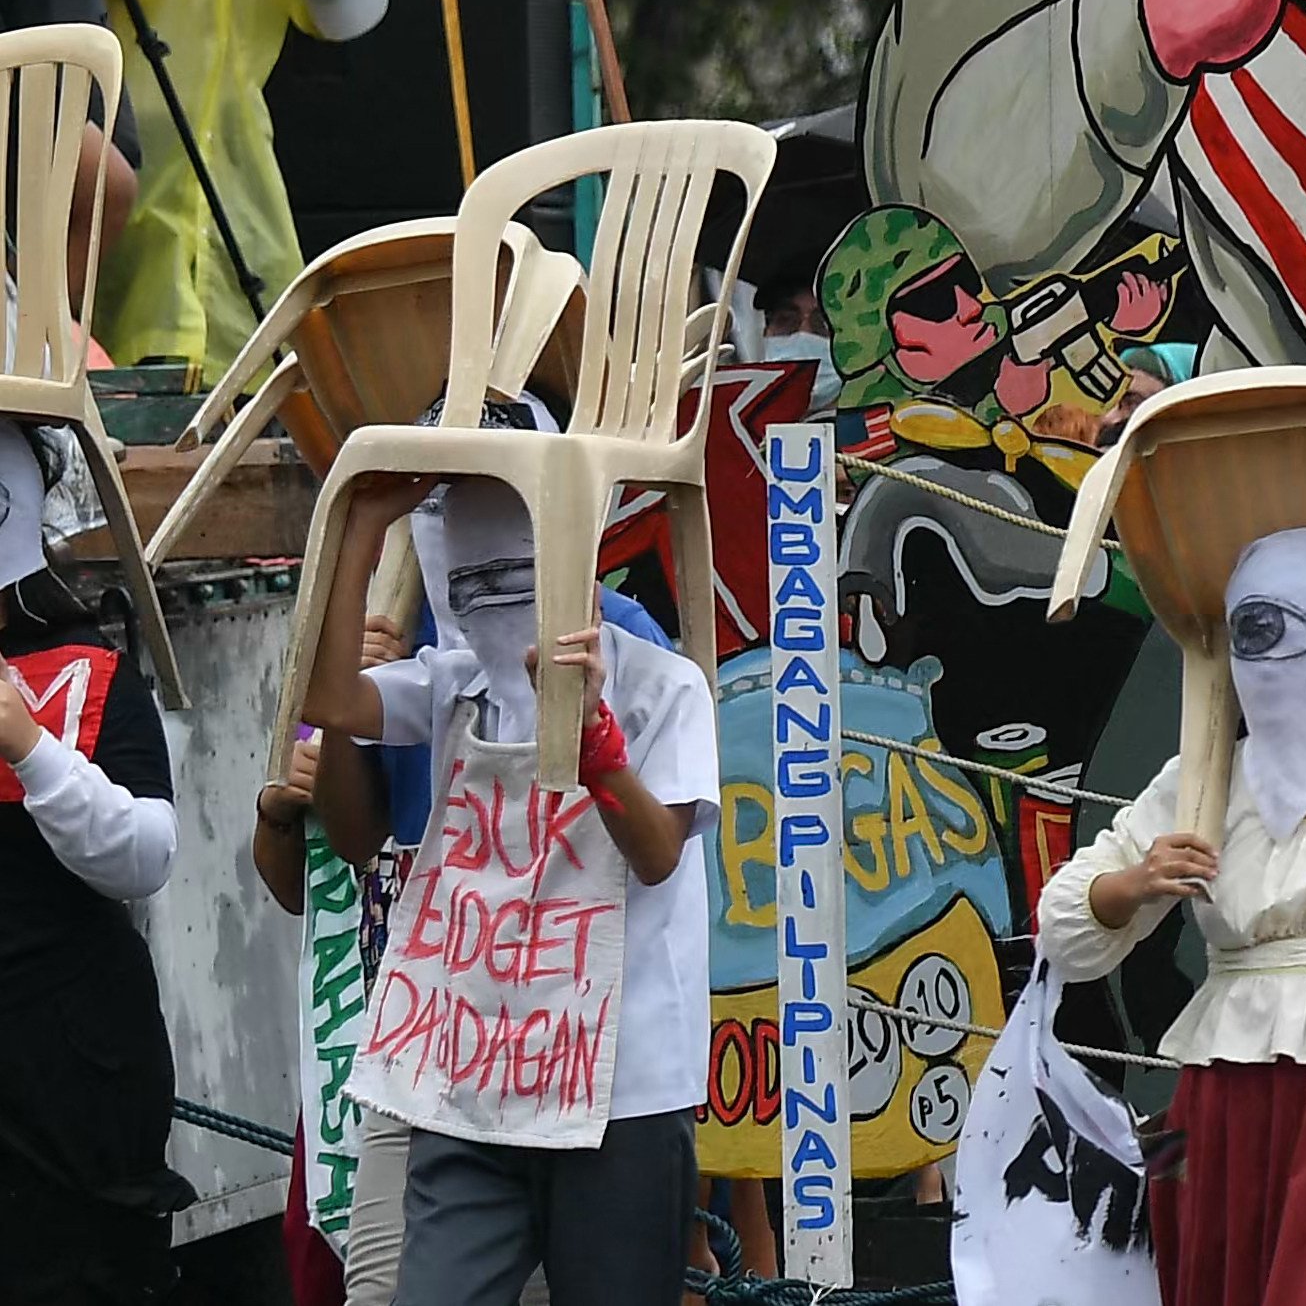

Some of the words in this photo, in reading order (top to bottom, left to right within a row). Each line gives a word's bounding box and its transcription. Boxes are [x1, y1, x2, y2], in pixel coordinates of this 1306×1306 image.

[769, 437, 832, 798] UMBAGANG
[720, 738, 988, 928] BGAS
[779, 814, 838, 1230] PILIPINAS
